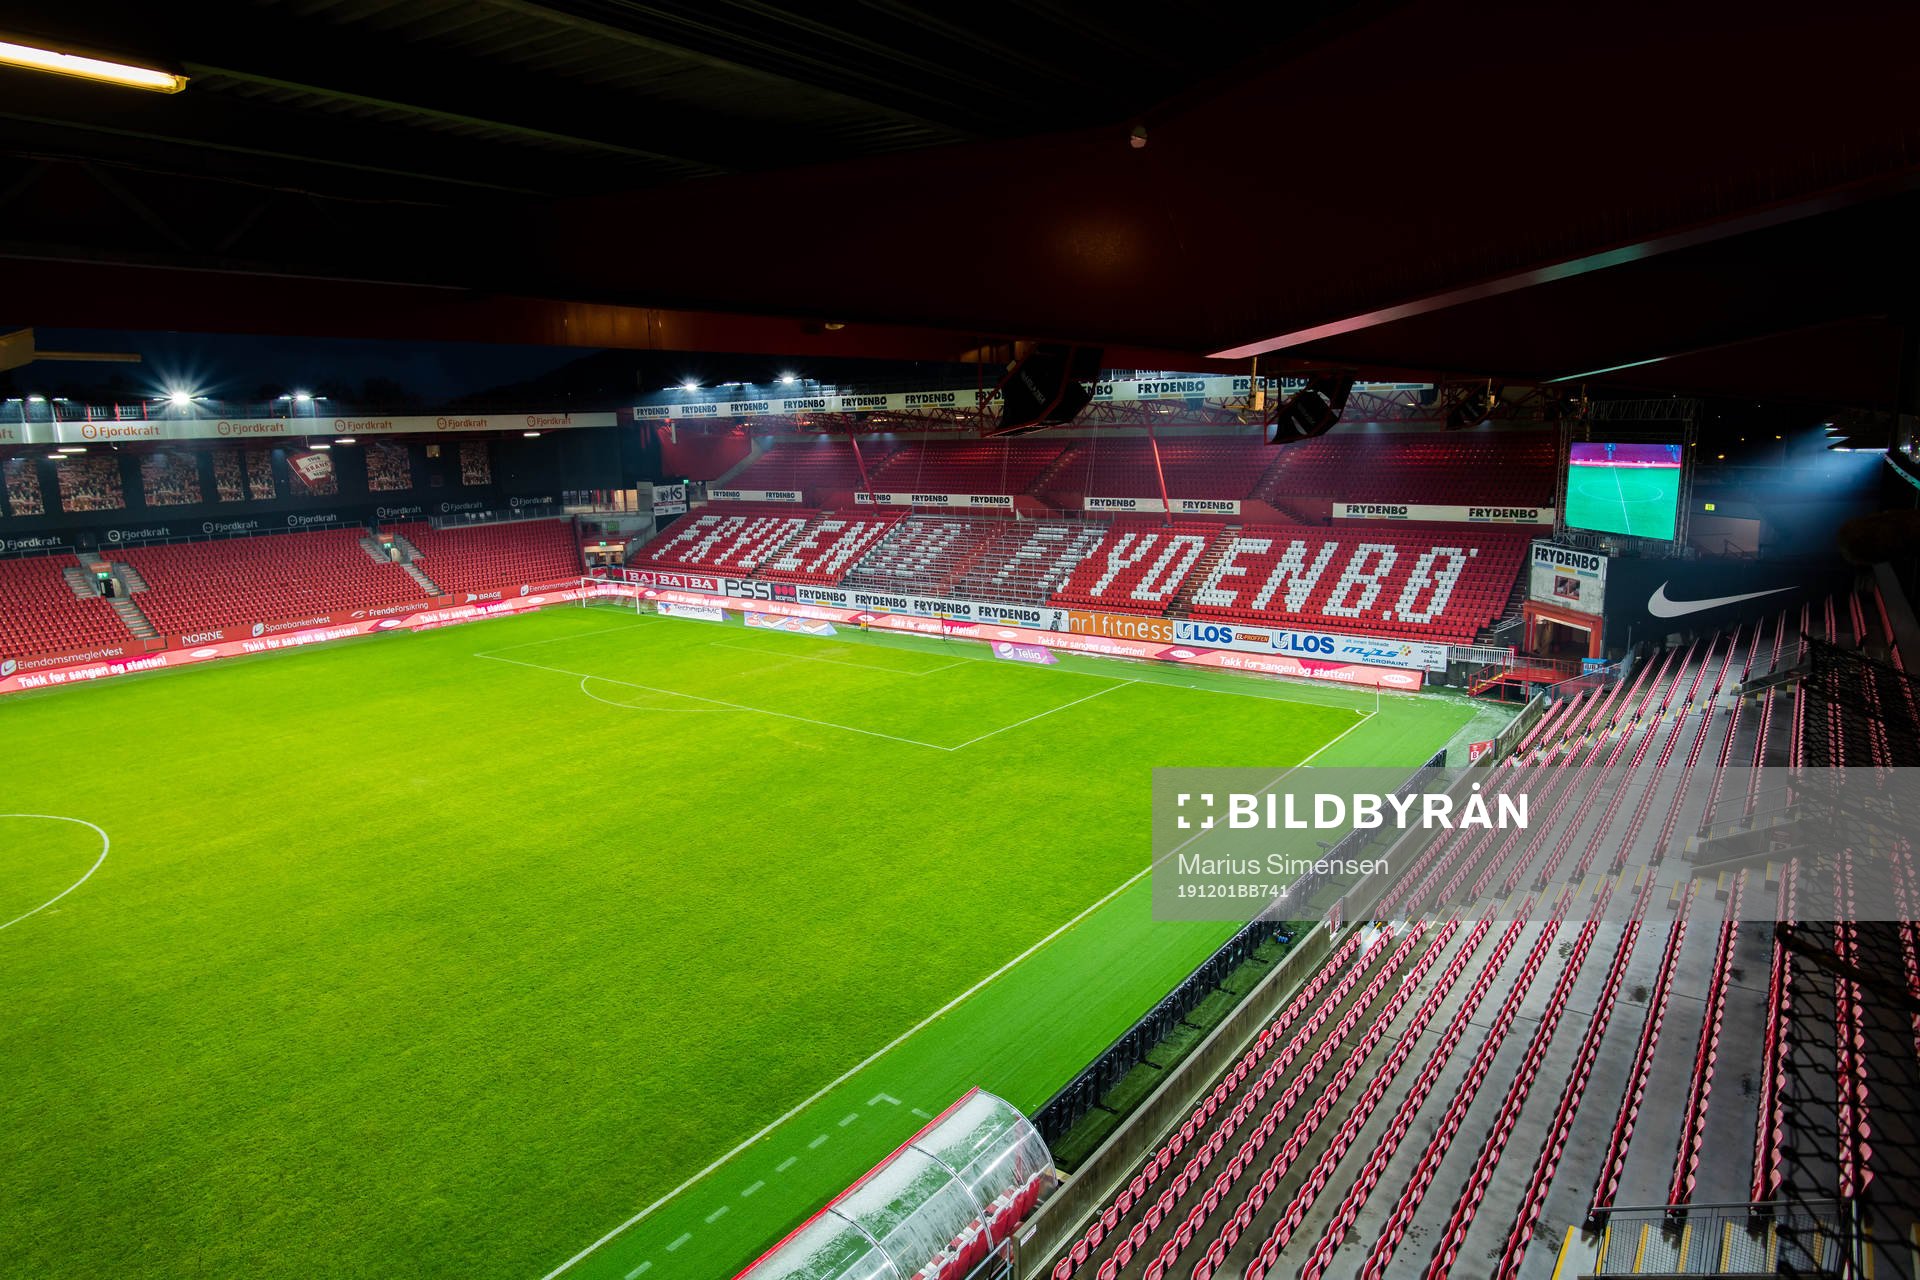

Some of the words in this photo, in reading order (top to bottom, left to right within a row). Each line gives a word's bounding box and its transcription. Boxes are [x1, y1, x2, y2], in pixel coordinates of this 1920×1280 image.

[1138, 379, 1205, 395] FRYDENBØ
[232, 422, 285, 434] Fjordkraft
[347, 420, 393, 431] Fjordkraft
[448, 419, 487, 429] Fjordkraft
[536, 416, 571, 426] Fjordkraft
[100, 425, 160, 439] Fjordkraft
[1346, 505, 1408, 516] FRYDENBØ
[1468, 507, 1538, 519] FRYDENBØ
[215, 520, 258, 532] Fjordkraft
[299, 513, 337, 525] Fjordkraft
[122, 527, 170, 540] Fjordkraft
[7, 536, 62, 550] Fjordkraft
[1535, 546, 1600, 571] FRYDENBØ
[630, 572, 650, 583] BA
[659, 574, 681, 587] BA
[691, 576, 714, 590] BA
[726, 579, 770, 600] PSS
[799, 588, 847, 603] FRYDENBØ
[855, 594, 907, 609] FRYDENBØ
[914, 600, 971, 615] FRYDENBØ
[978, 606, 1041, 622] FRYDENBØ
[1102, 615, 1173, 641] fitness
[1193, 625, 1233, 644] LOS
[182, 630, 224, 645] NORNE
[1038, 635, 1056, 646] Takk
[1291, 635, 1335, 655] LOS
[1016, 647, 1042, 660] Telia
[1220, 656, 1241, 667] Takk
[1243, 659, 1258, 669] for
[1260, 662, 1296, 675] sangen
[1298, 667, 1312, 678] og
[1313, 669, 1355, 681] støtten!
[18, 676, 47, 688] Takk
